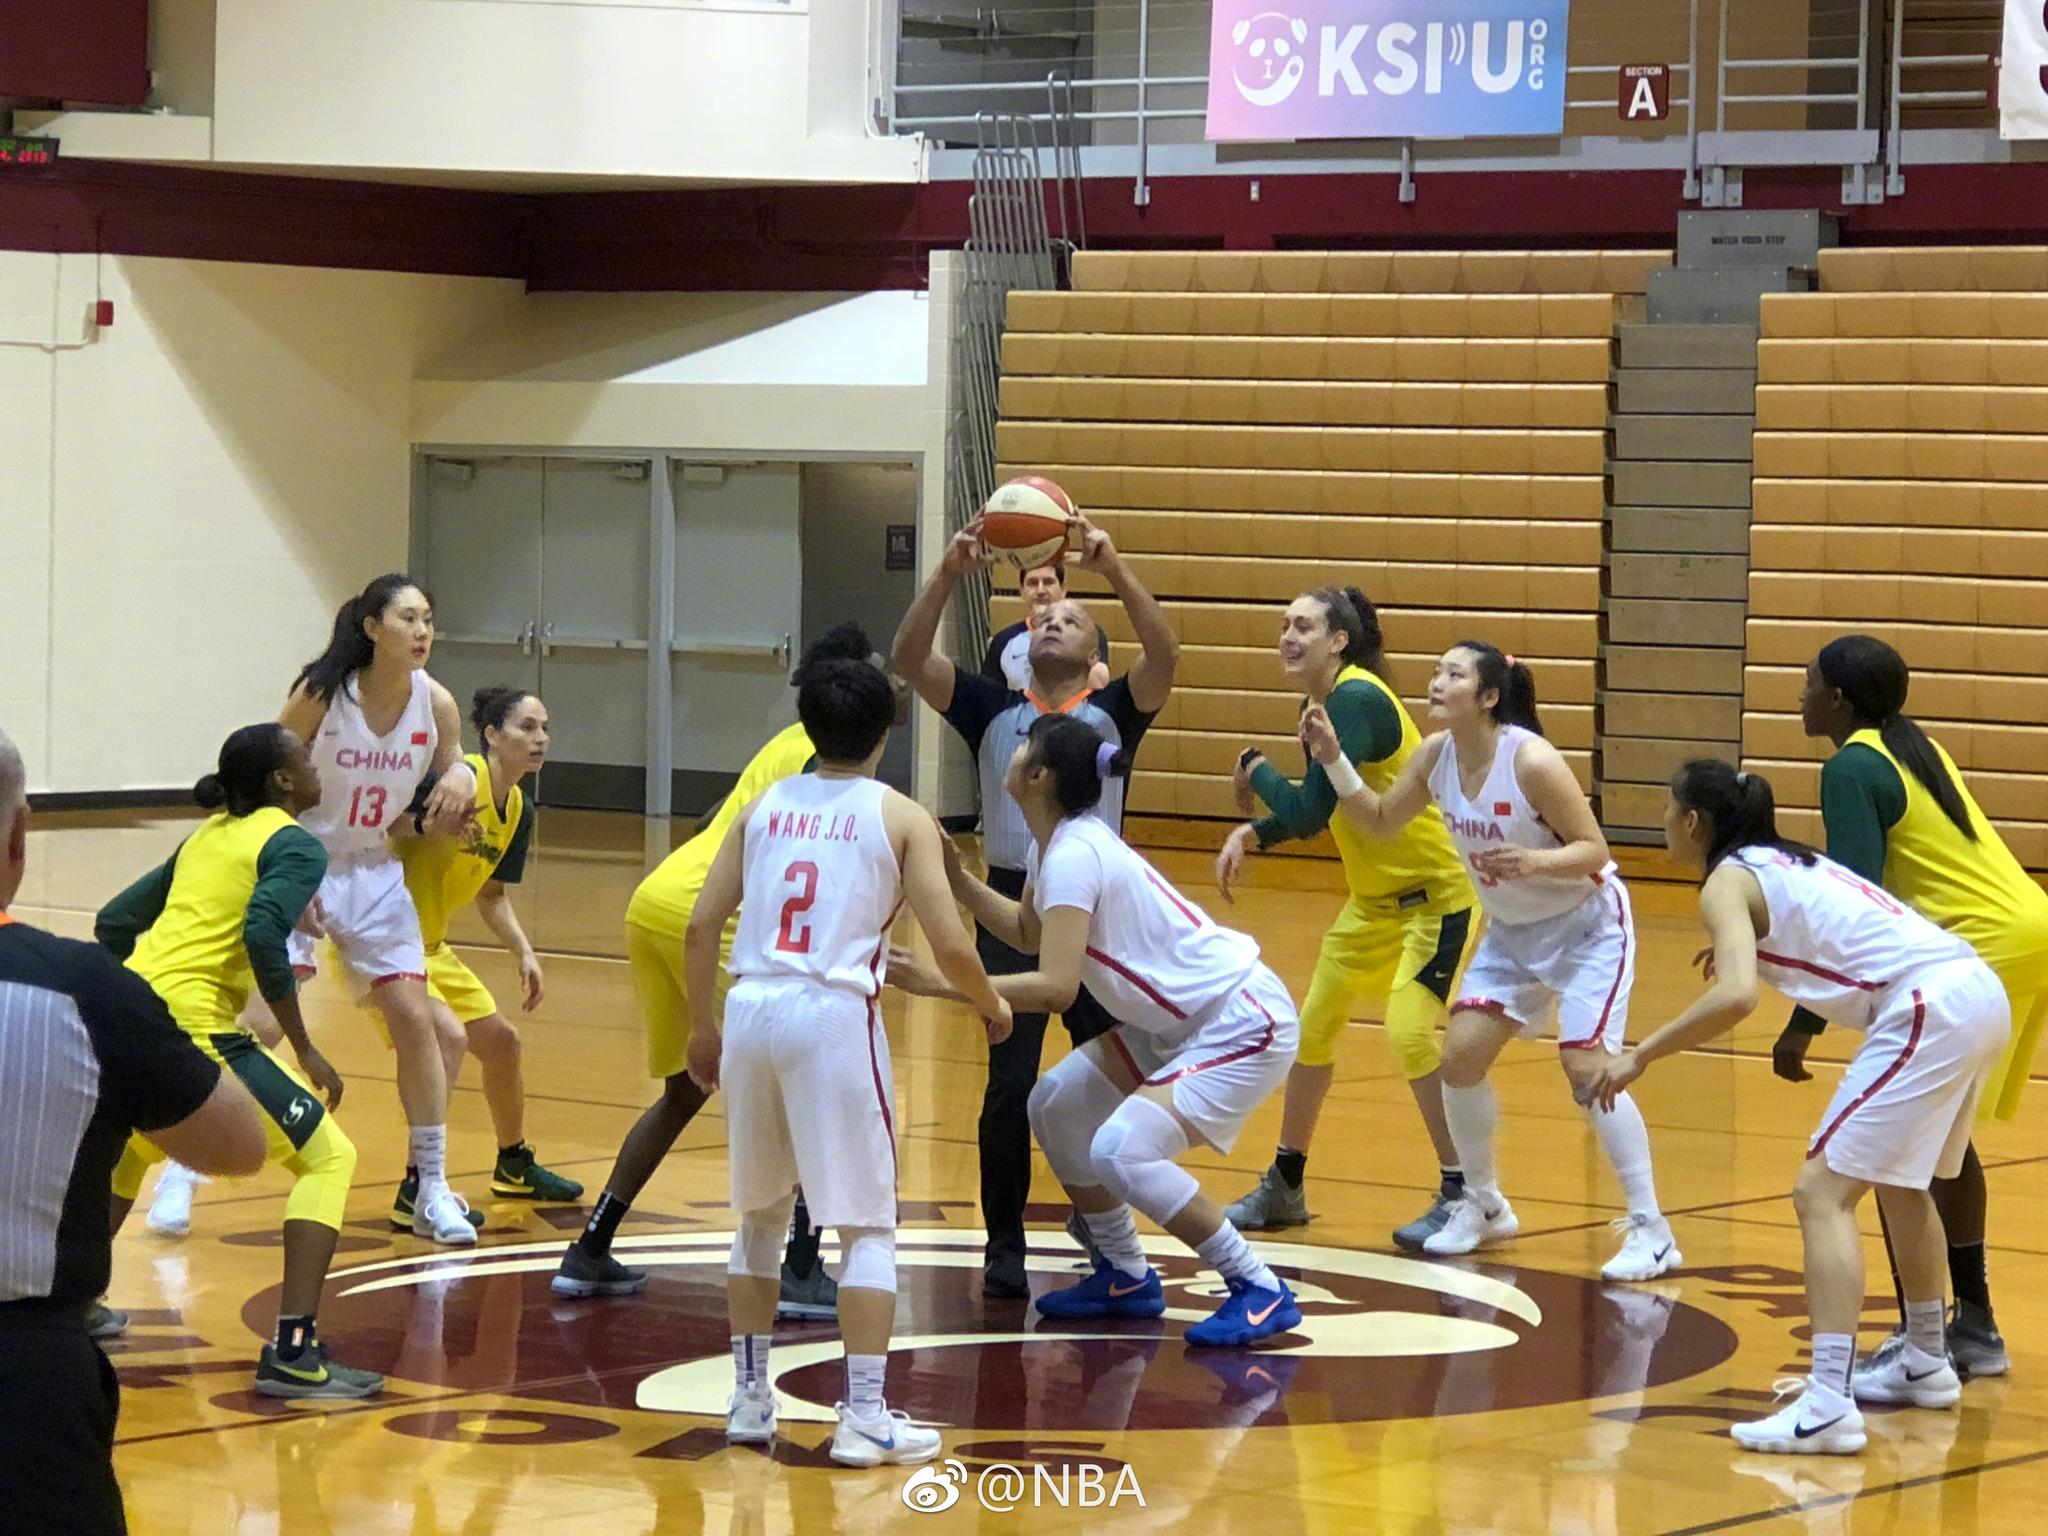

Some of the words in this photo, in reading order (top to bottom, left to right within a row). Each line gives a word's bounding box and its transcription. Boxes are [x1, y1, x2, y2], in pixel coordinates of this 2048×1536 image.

[1528, 18, 1549, 91] ORG
[1625, 66, 1663, 77] SECTION
[1627, 77, 1658, 118] A
[335, 748, 414, 770] CHINA
[347, 784, 387, 828] 13
[768, 810, 822, 840] WANG
[775, 860, 819, 954] 2
